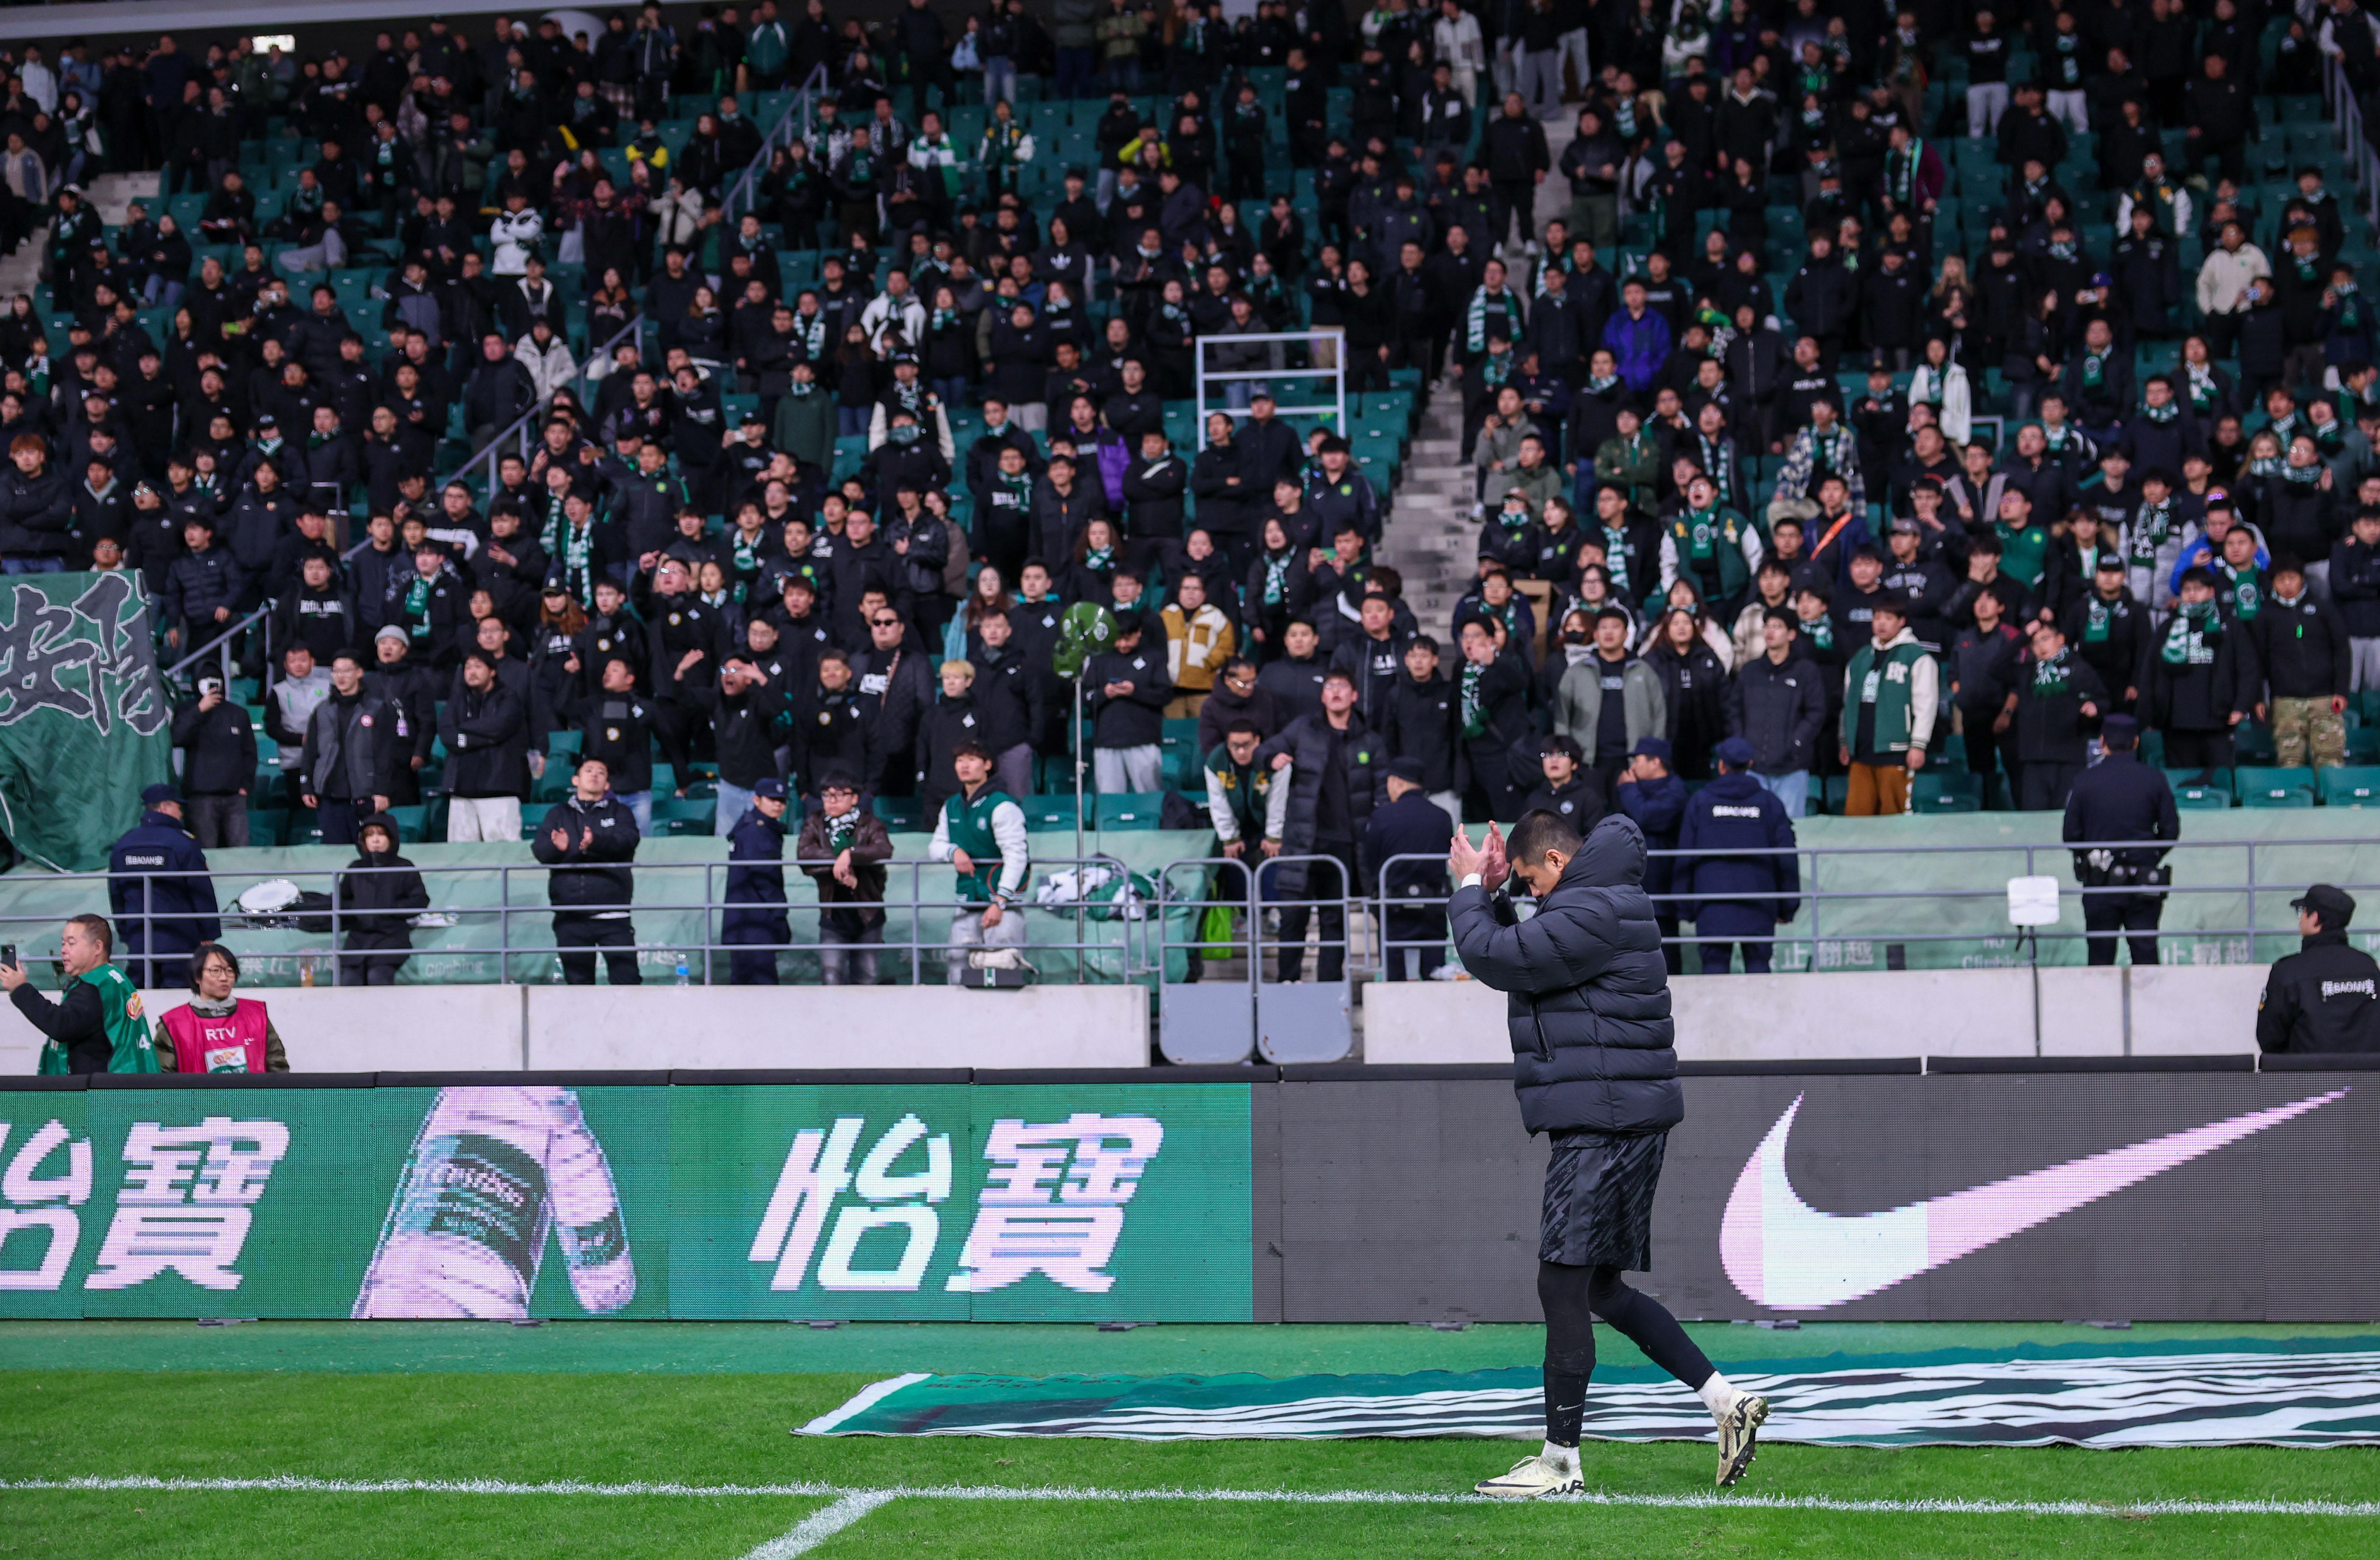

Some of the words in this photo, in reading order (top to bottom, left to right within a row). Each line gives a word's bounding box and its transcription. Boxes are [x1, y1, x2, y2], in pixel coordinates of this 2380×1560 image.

[1768, 940, 1874, 970] 止翻越
[205, 1026, 236, 1041] RTV
[749, 1113, 1164, 1293] 怡寶
